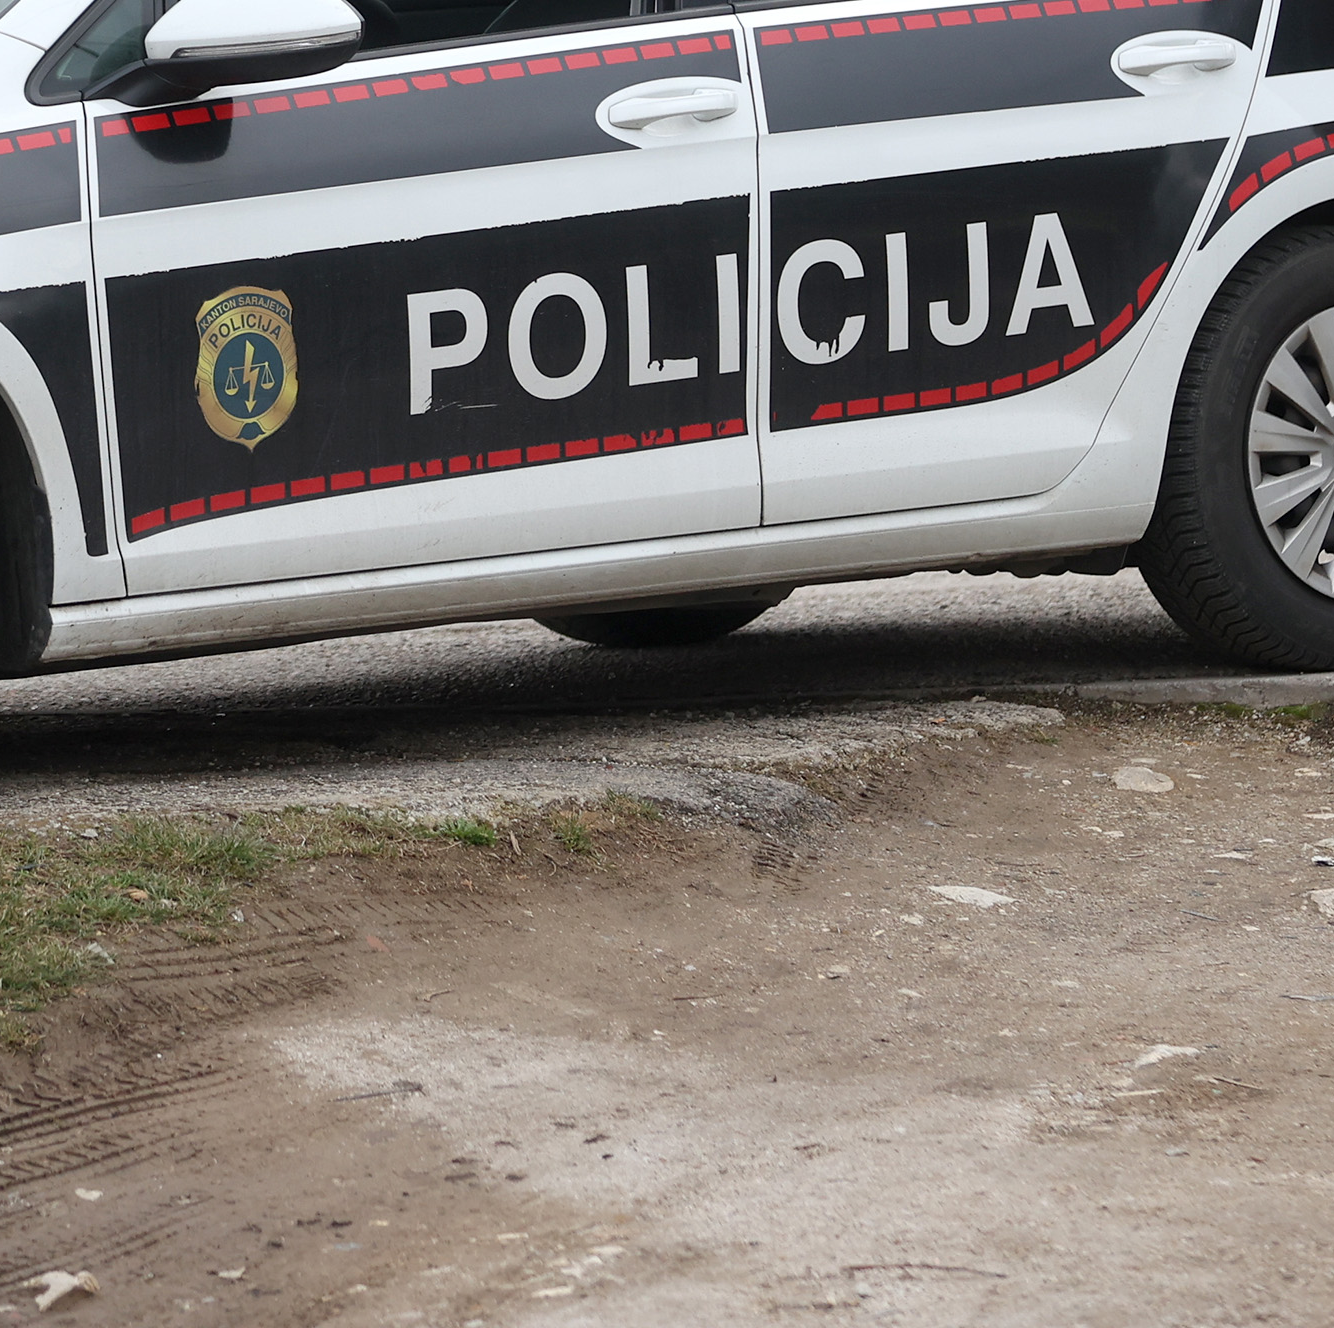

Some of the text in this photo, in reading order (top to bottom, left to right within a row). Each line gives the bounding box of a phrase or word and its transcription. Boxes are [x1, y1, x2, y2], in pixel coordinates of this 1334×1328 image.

[200, 296, 288, 330] KANTON SARAJEVO
[208, 313, 282, 349] POLICIJA
[406, 211, 1096, 416] POLICIJA
